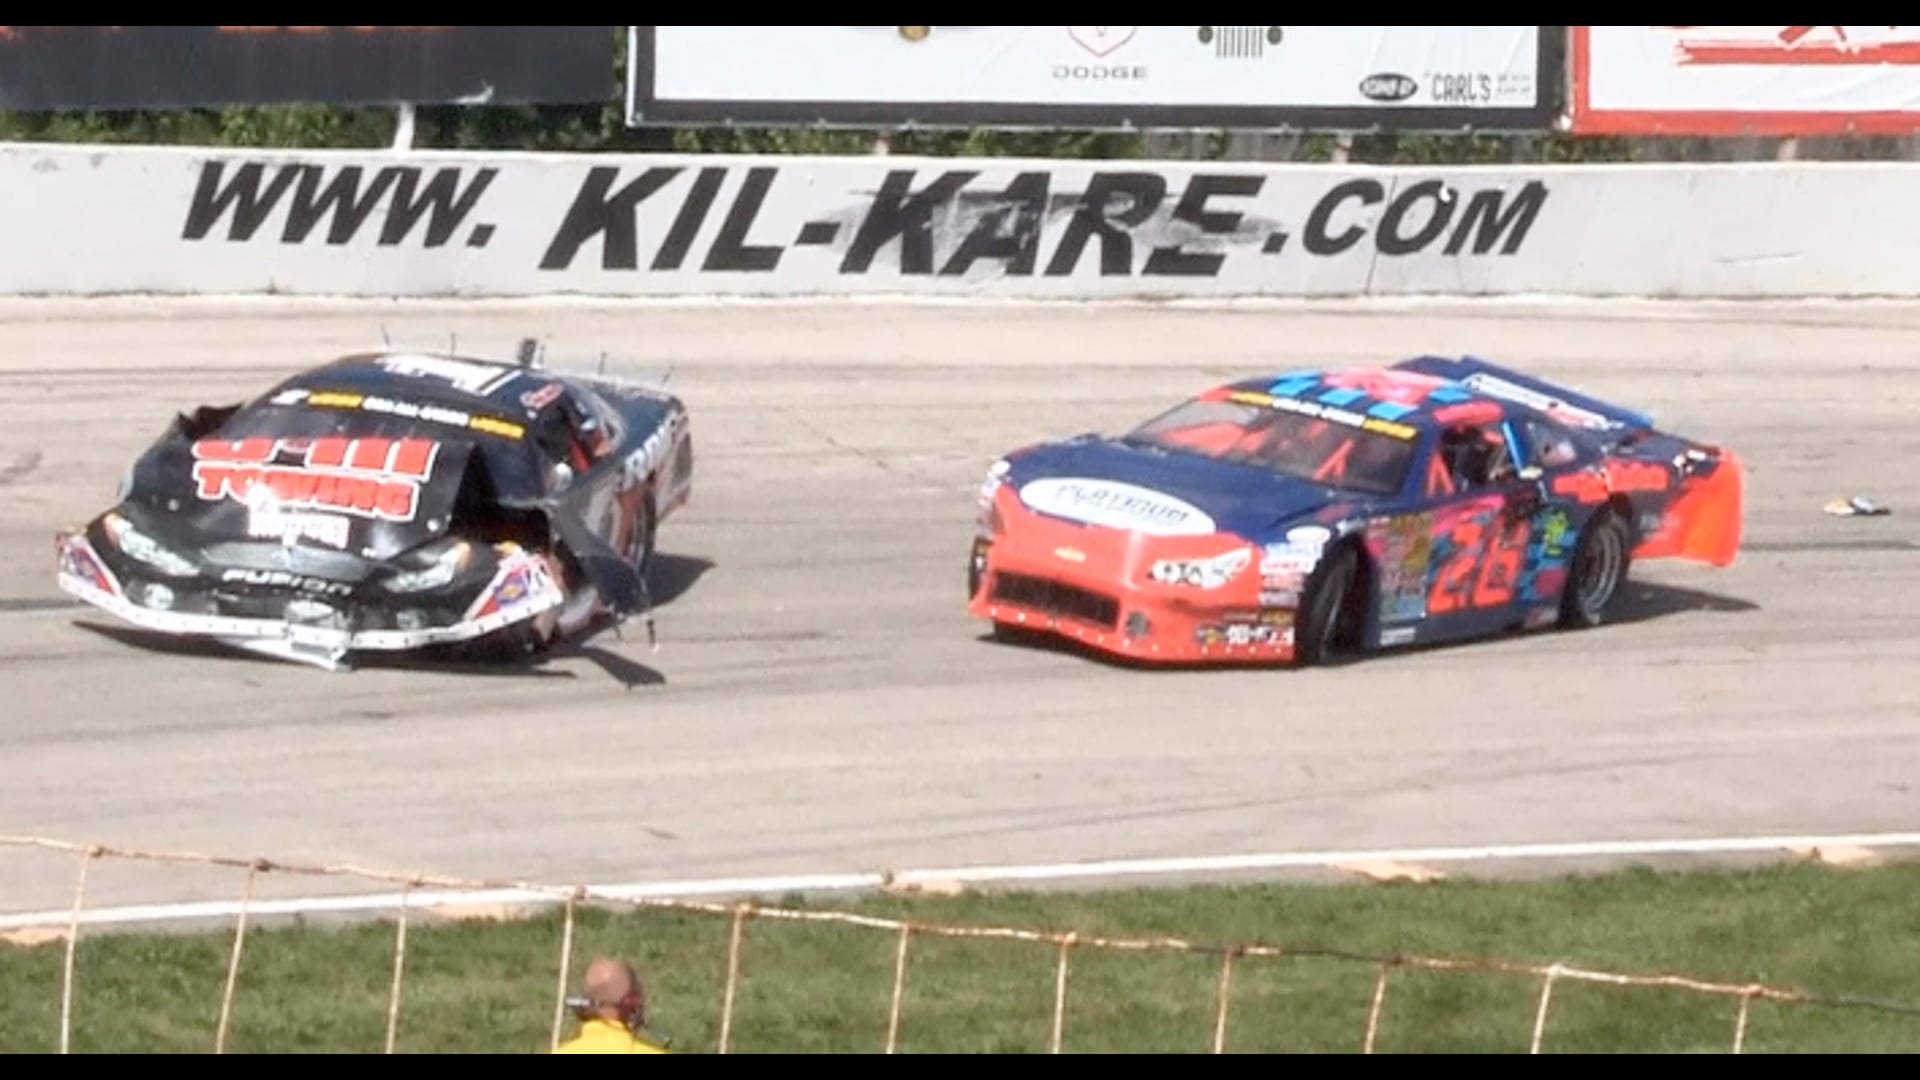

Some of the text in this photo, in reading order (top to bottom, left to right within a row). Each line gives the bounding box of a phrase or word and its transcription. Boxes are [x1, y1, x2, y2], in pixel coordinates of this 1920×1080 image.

[1052, 65, 1147, 80] DODGE
[181, 161, 500, 248] WWW.
[193, 461, 420, 521] TOWING
[222, 569, 353, 596] FUSION
